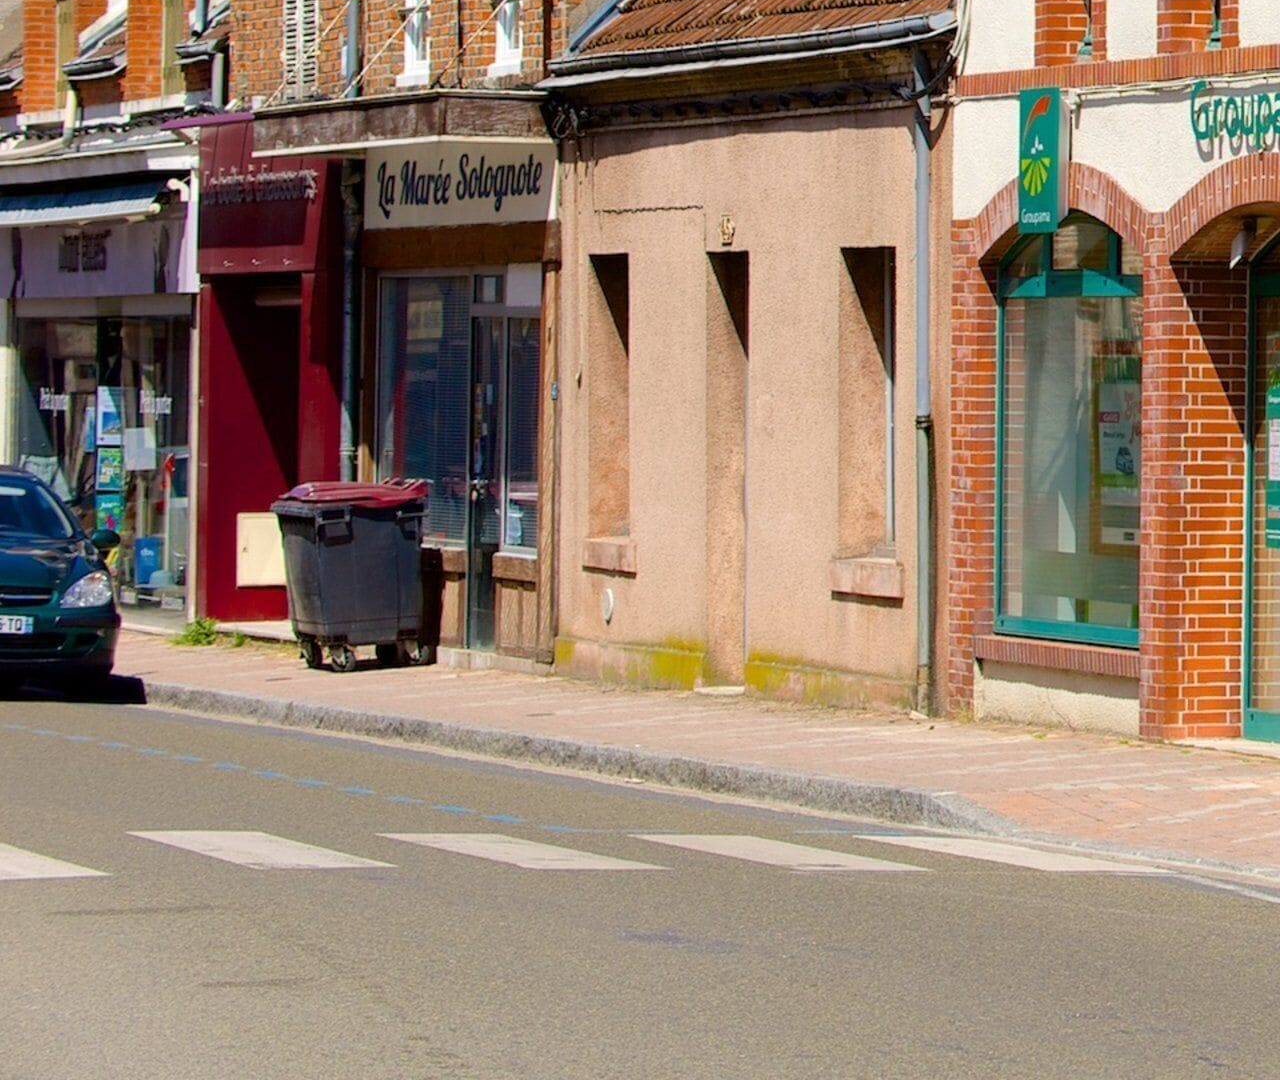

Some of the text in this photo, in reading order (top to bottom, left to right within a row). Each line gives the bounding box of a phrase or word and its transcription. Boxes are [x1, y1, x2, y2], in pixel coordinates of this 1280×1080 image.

[377, 153, 542, 220] La Marée Solognote
[1020, 208, 1051, 226] Groupama
